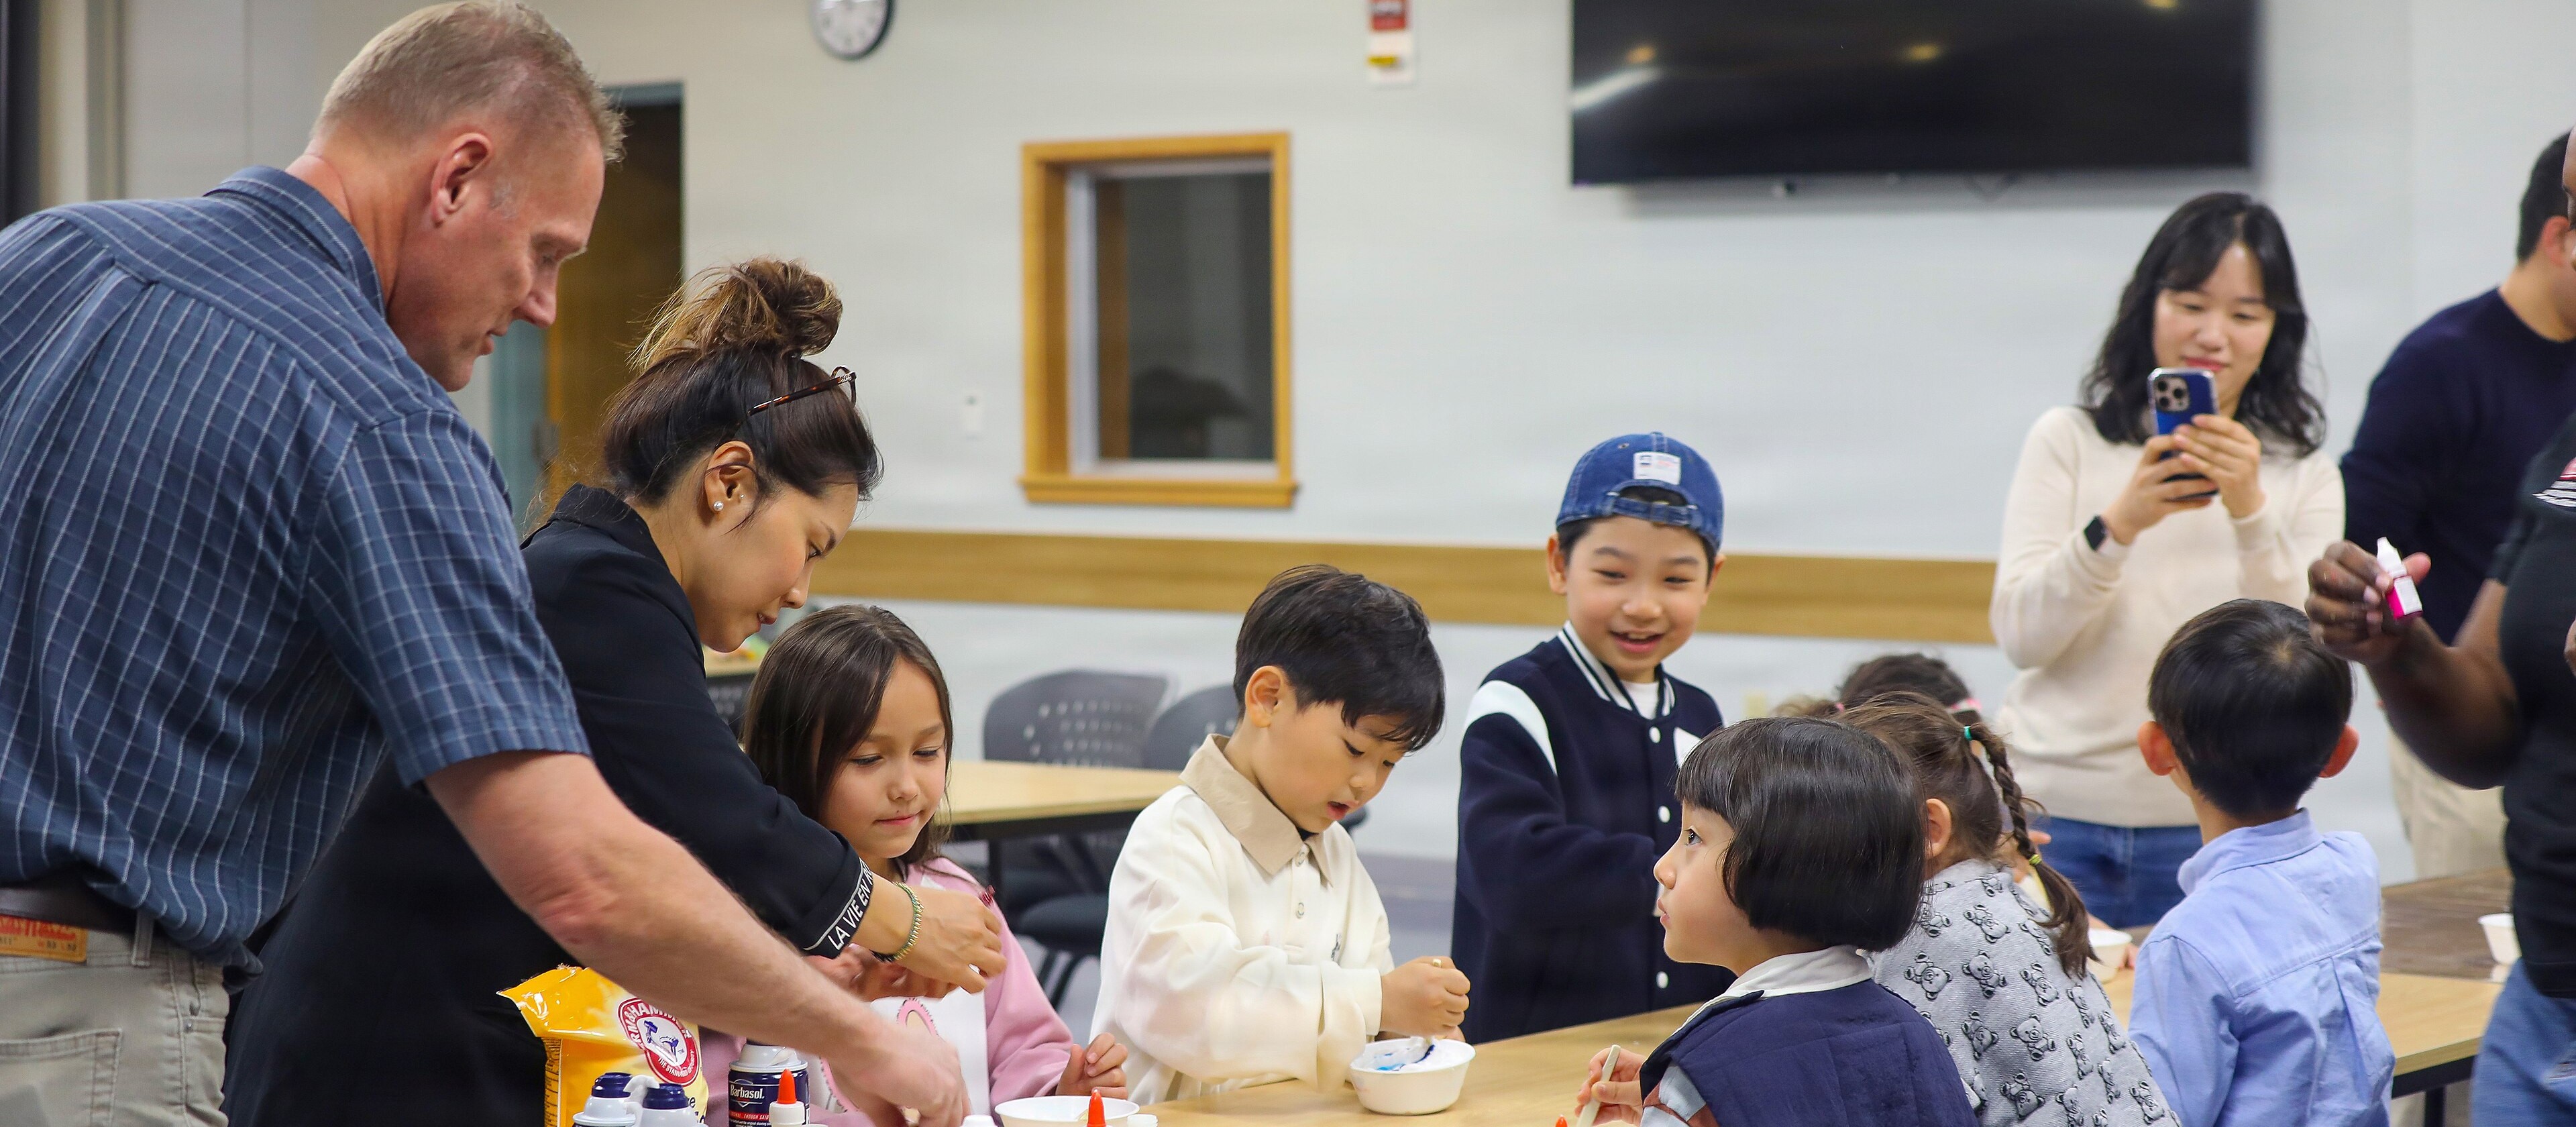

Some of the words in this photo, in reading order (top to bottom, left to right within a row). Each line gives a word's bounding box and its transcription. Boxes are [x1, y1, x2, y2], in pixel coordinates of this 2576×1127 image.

[828, 926, 851, 950] LA
[843, 900, 863, 928] VIE
[857, 878, 871, 907] EN
[658, 1057, 667, 1069] THE
